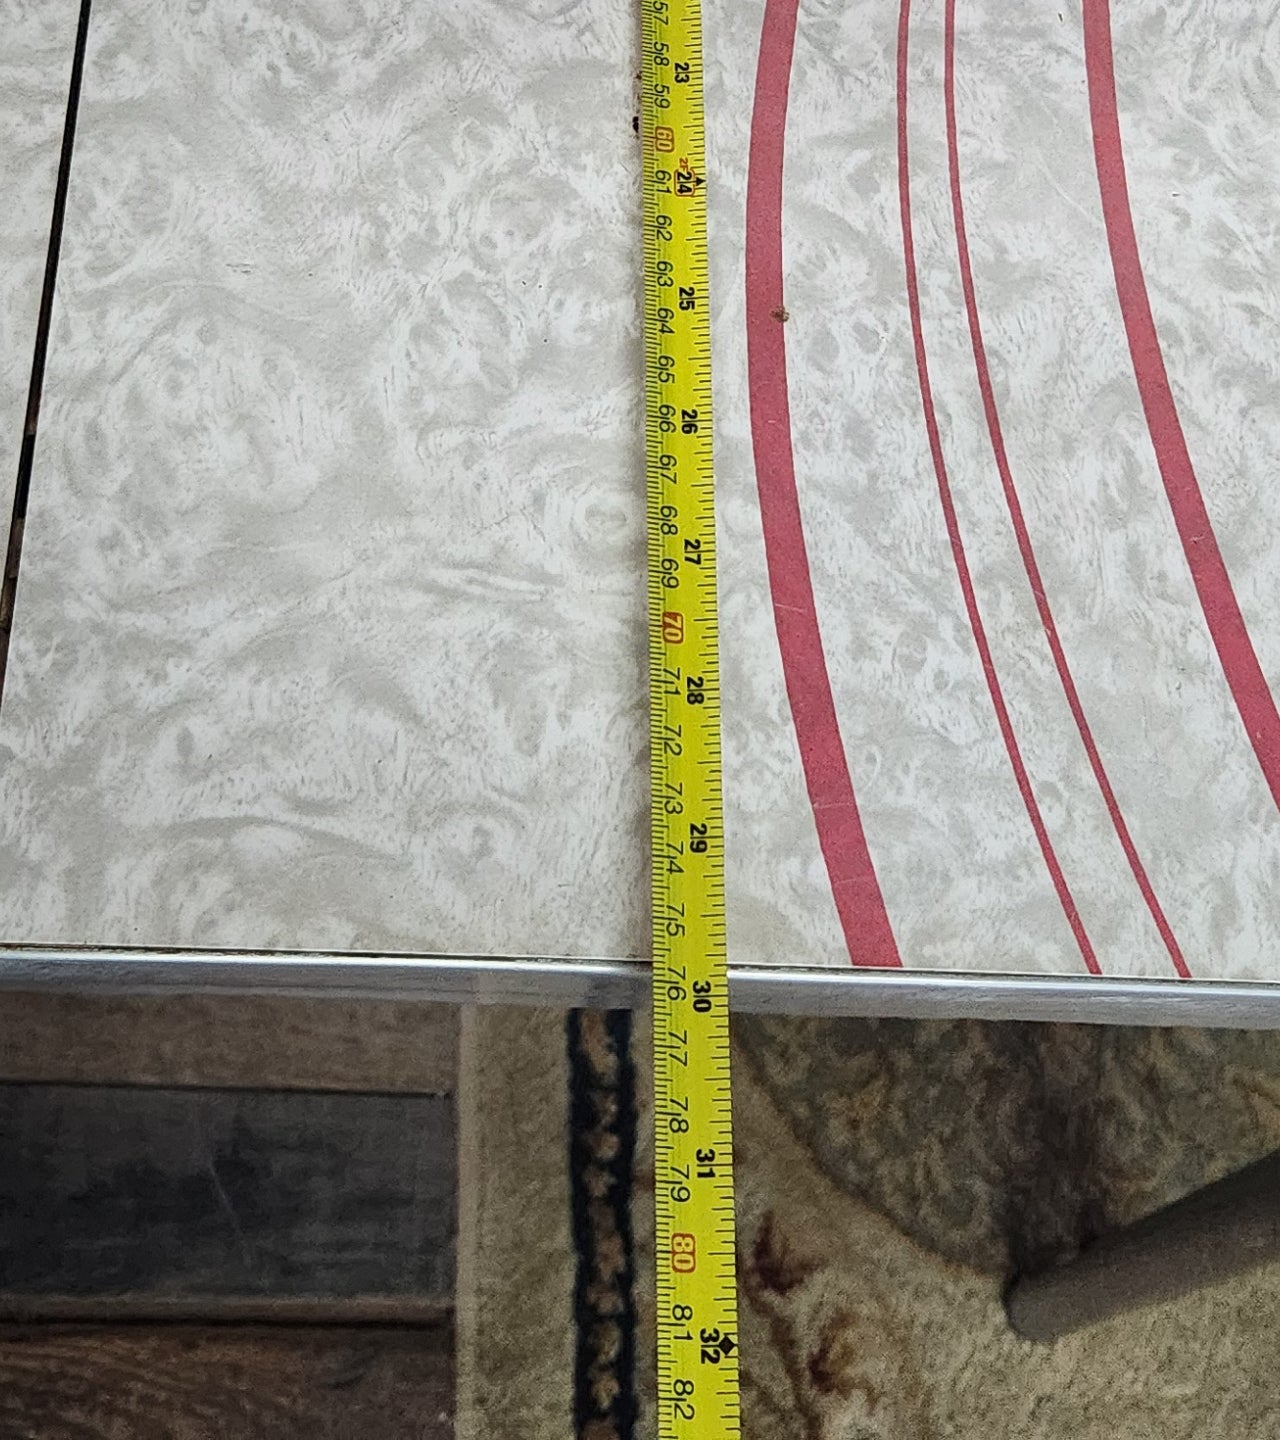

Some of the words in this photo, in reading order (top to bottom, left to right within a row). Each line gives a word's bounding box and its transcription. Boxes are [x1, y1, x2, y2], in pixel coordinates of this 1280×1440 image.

[653, 1, 669, 25] 57
[654, 41, 669, 66] 58
[674, 62, 690, 84] 23
[655, 83, 670, 109] 59
[656, 128, 673, 152] 60
[656, 170, 672, 194] 61
[677, 171, 692, 194] 24
[657, 215, 672, 241] 62
[657, 261, 673, 287] 63
[679, 286, 695, 311] 25
[658, 307, 675, 334] 64
[659, 355, 675, 383] 65
[659, 404, 676, 433] 66
[681, 409, 698, 434] 26
[661, 454, 677, 484] 67
[661, 505, 678, 535] 68
[684, 539, 701, 565] 27
[662, 559, 679, 589] 69
[663, 614, 682, 643] 70
[663, 667, 681, 695] 71
[687, 676, 704, 705] 28
[664, 725, 682, 756] 72
[665, 782, 683, 814] 73
[690, 823, 707, 853] 29
[666, 841, 684, 874] 74
[667, 902, 685, 937] 75
[668, 966, 686, 1001] 76
[693, 980, 711, 1013] 30
[669, 1030, 687, 1066] 77
[670, 1096, 689, 1133] 78
[696, 1149, 715, 1178] 31
[670, 1164, 690, 1203] 79
[673, 1235, 694, 1271] 80
[673, 1304, 693, 1341] 81
[700, 1328, 720, 1364] 32
[674, 1379, 695, 1420] 82
